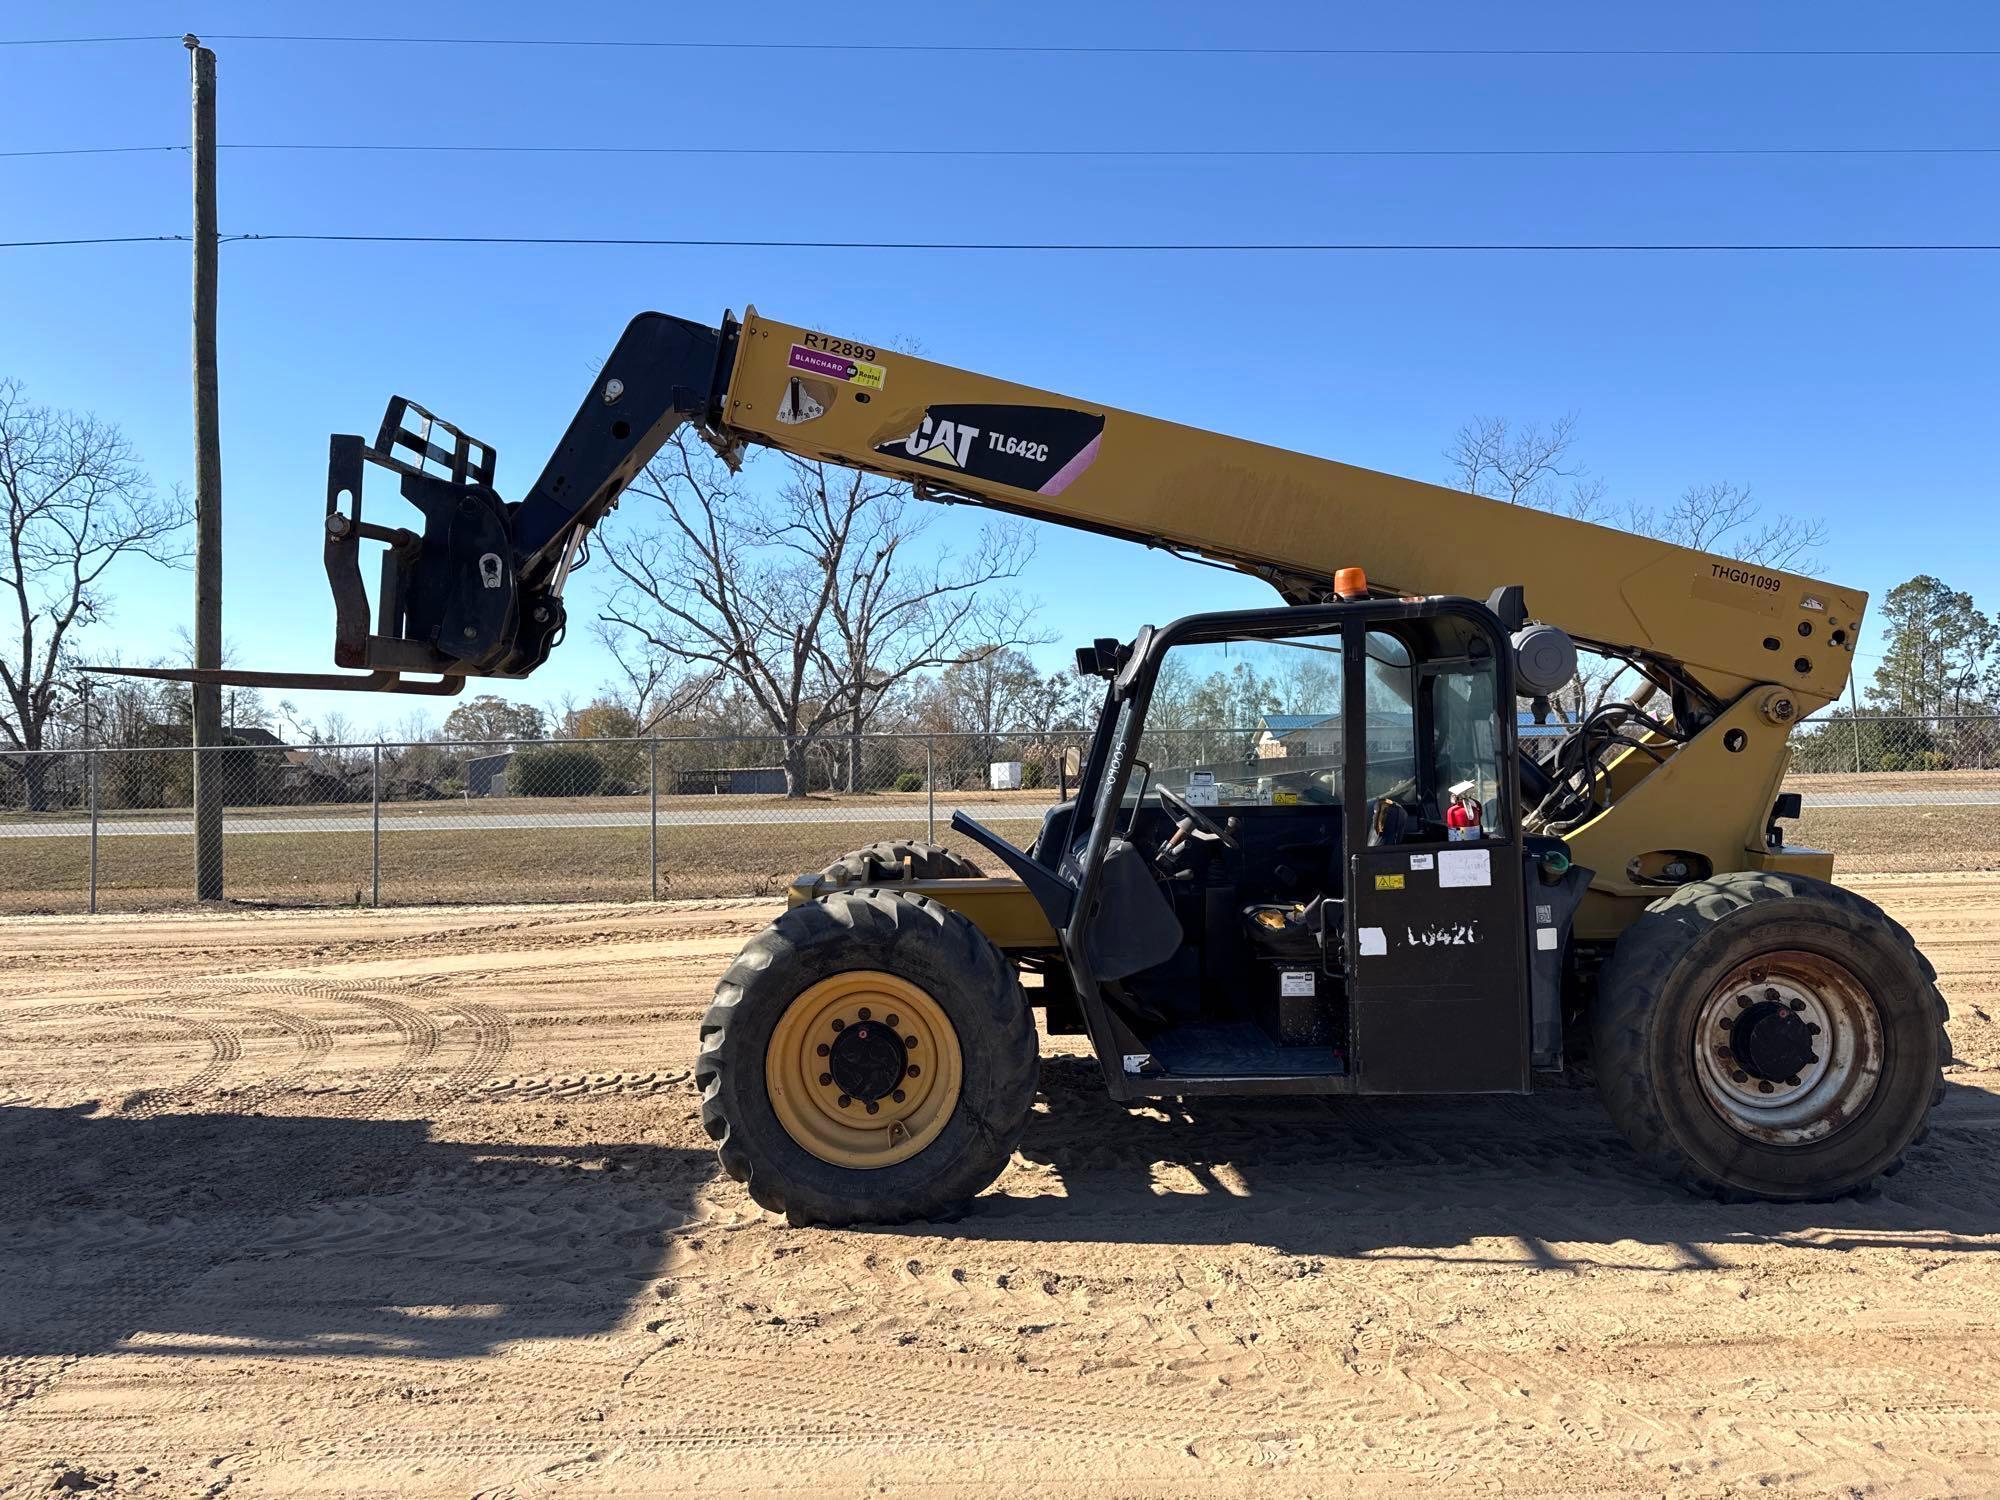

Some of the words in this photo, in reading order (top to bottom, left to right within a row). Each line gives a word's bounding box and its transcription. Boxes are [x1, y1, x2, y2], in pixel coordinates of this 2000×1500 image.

[804, 333, 876, 361] R12899
[795, 354, 843, 371] BLANCHARD
[858, 371, 880, 381] Rental
[905, 413, 980, 468] CAT
[987, 431, 1049, 462] TL642C
[1711, 563, 1781, 592] THG01099
